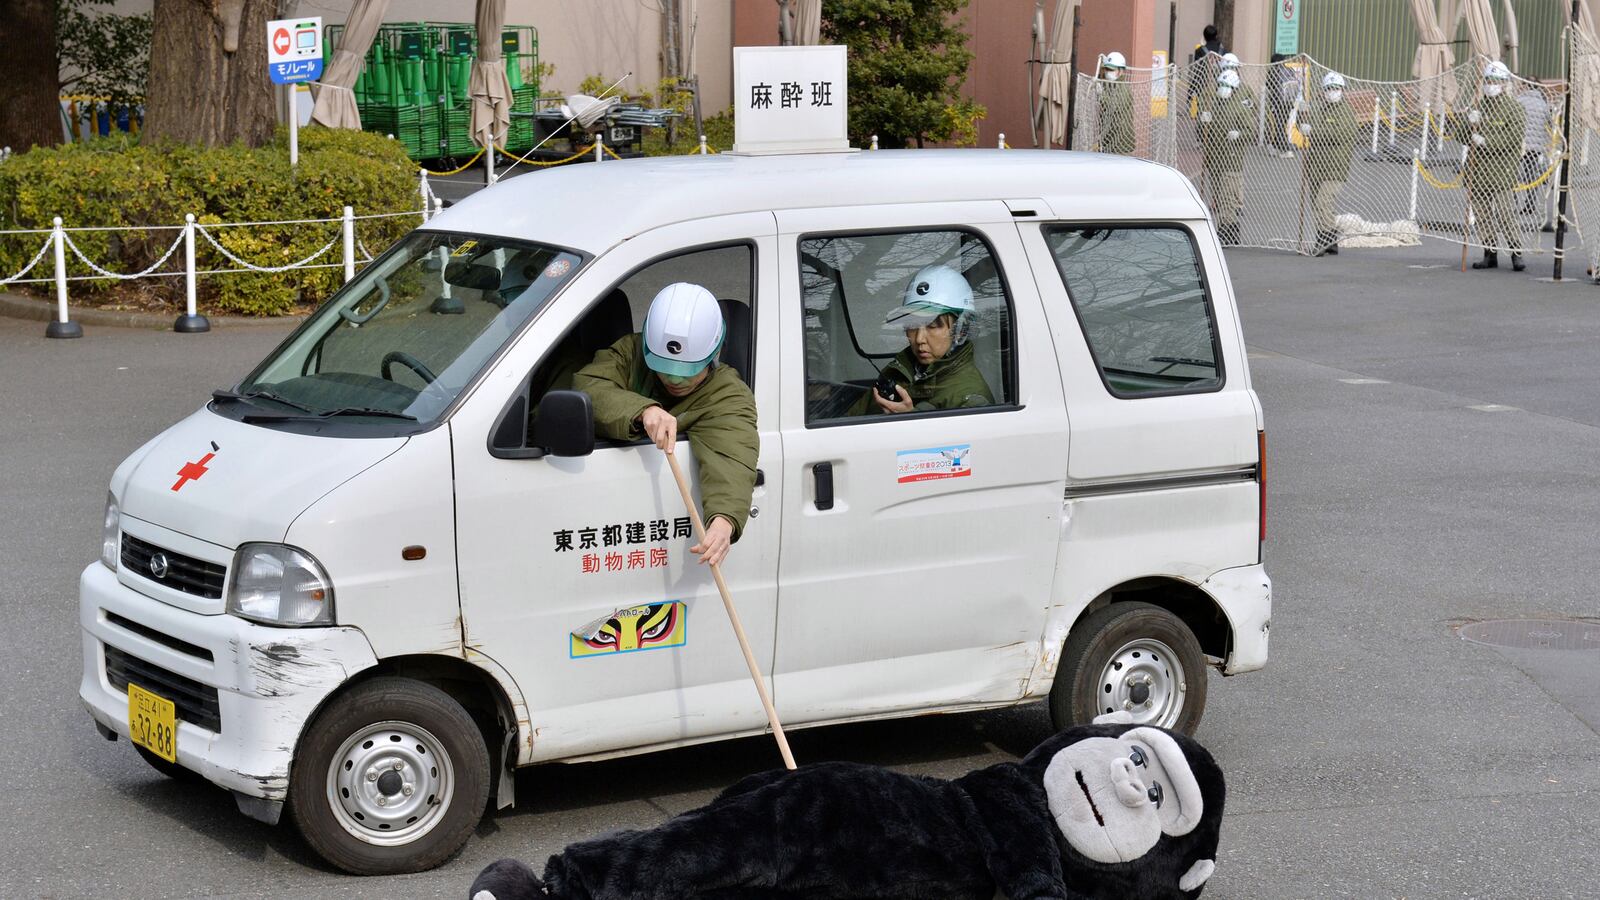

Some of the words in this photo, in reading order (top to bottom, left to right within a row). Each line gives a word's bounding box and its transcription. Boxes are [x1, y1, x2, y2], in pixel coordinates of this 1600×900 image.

[277, 61, 315, 75] モノレール
[750, 81, 833, 109] 麻酔班
[553, 516, 693, 552] 東京都建設局
[581, 547, 668, 573] 動物病院
